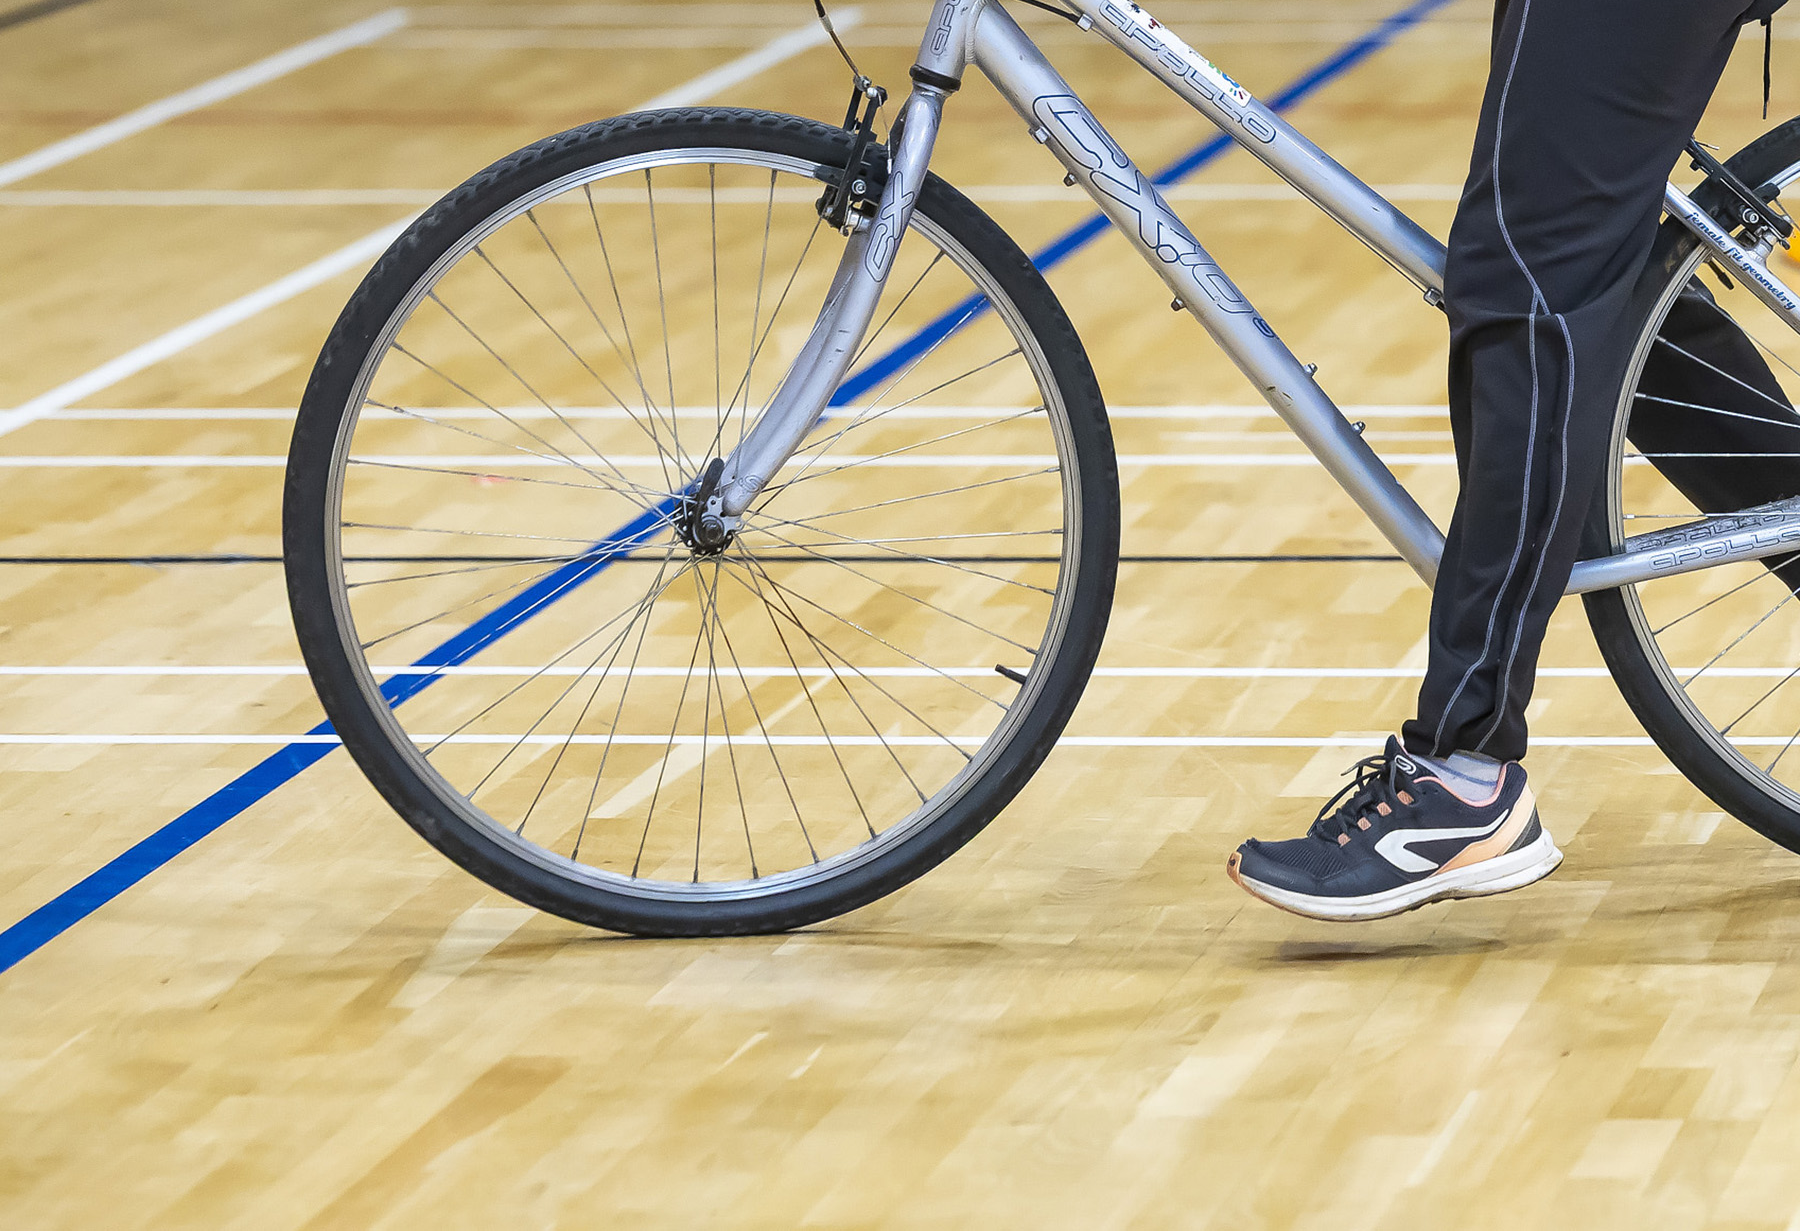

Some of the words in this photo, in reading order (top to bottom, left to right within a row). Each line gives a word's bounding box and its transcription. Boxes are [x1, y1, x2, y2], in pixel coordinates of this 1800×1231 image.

[1684, 211, 1727, 247] female
[1724, 246, 1744, 263] fit
[1740, 262, 1797, 311] geometry
